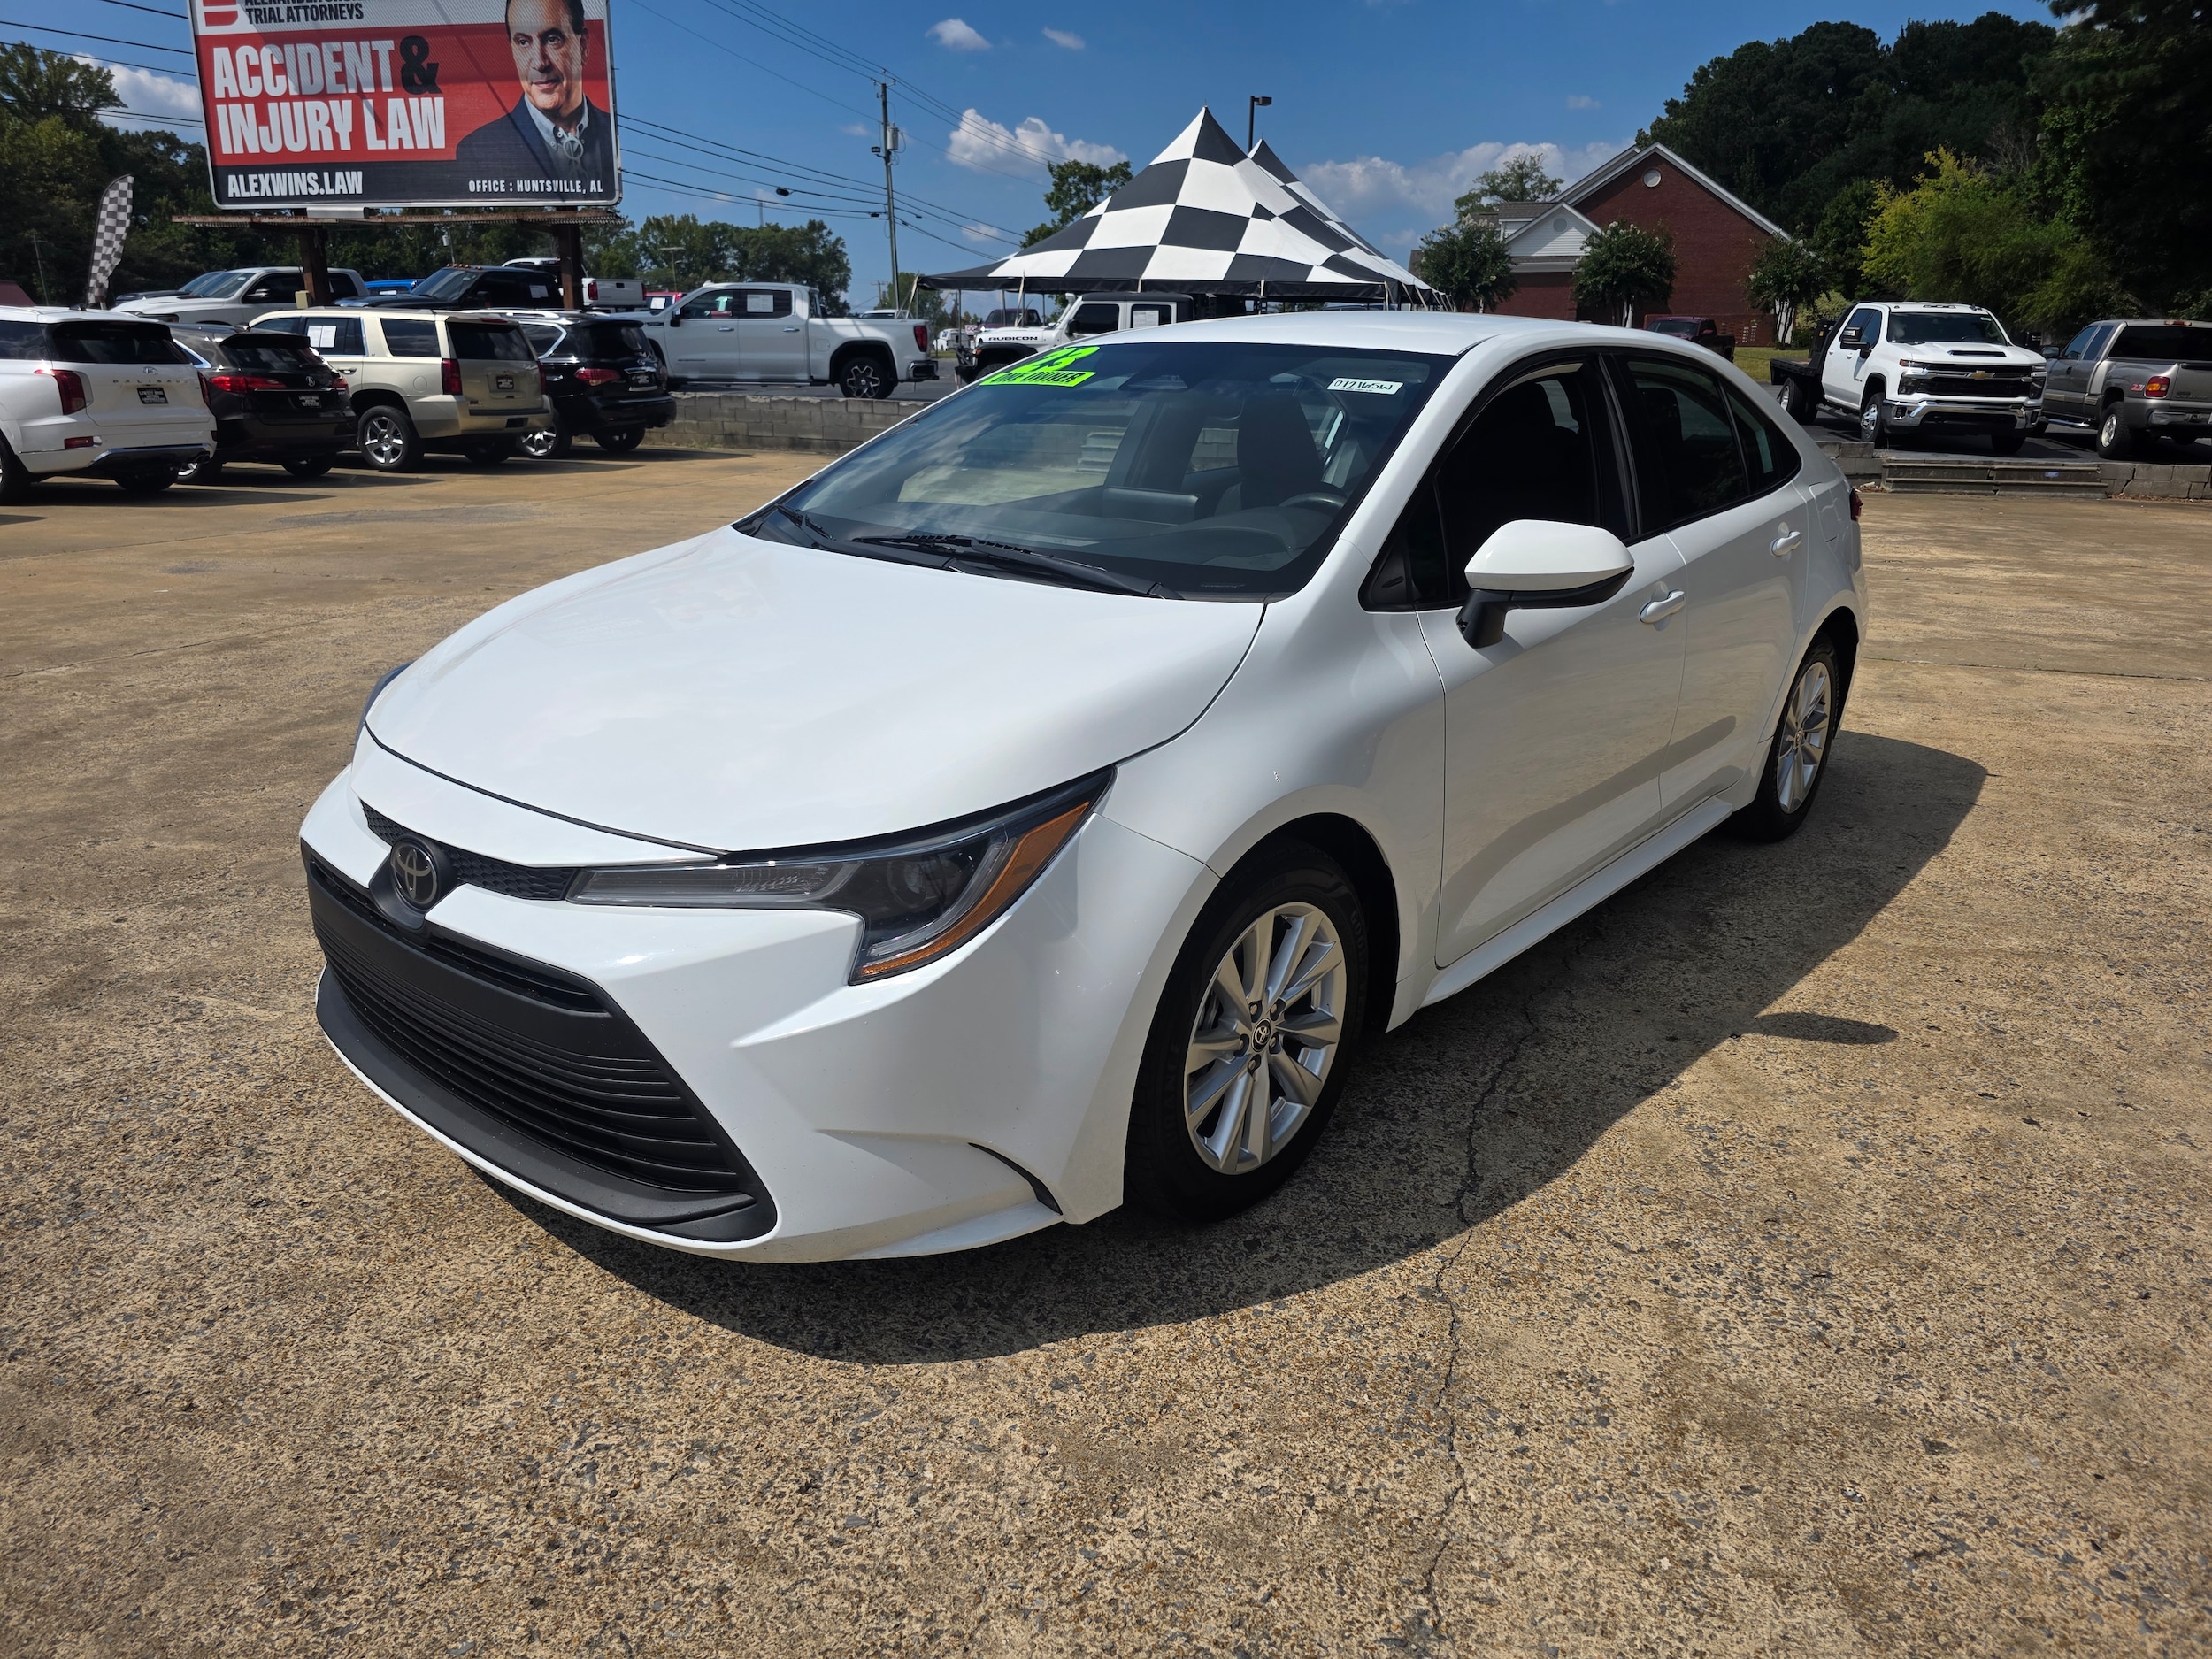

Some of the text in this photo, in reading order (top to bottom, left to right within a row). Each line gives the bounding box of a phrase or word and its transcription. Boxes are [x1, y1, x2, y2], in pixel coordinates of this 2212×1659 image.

[245, 4, 365, 25] TRIAL ATTORNEYS
[212, 35, 443, 99] ACCIDENT &
[215, 97, 446, 155] INJURY LAW
[227, 171, 364, 199] ALEXWINS.LAW
[468, 180, 506, 193] OFFICE
[516, 180, 587, 195] HUNTSVILLE,
[589, 180, 603, 194] AL
[1021, 371, 1086, 384] OWNER
